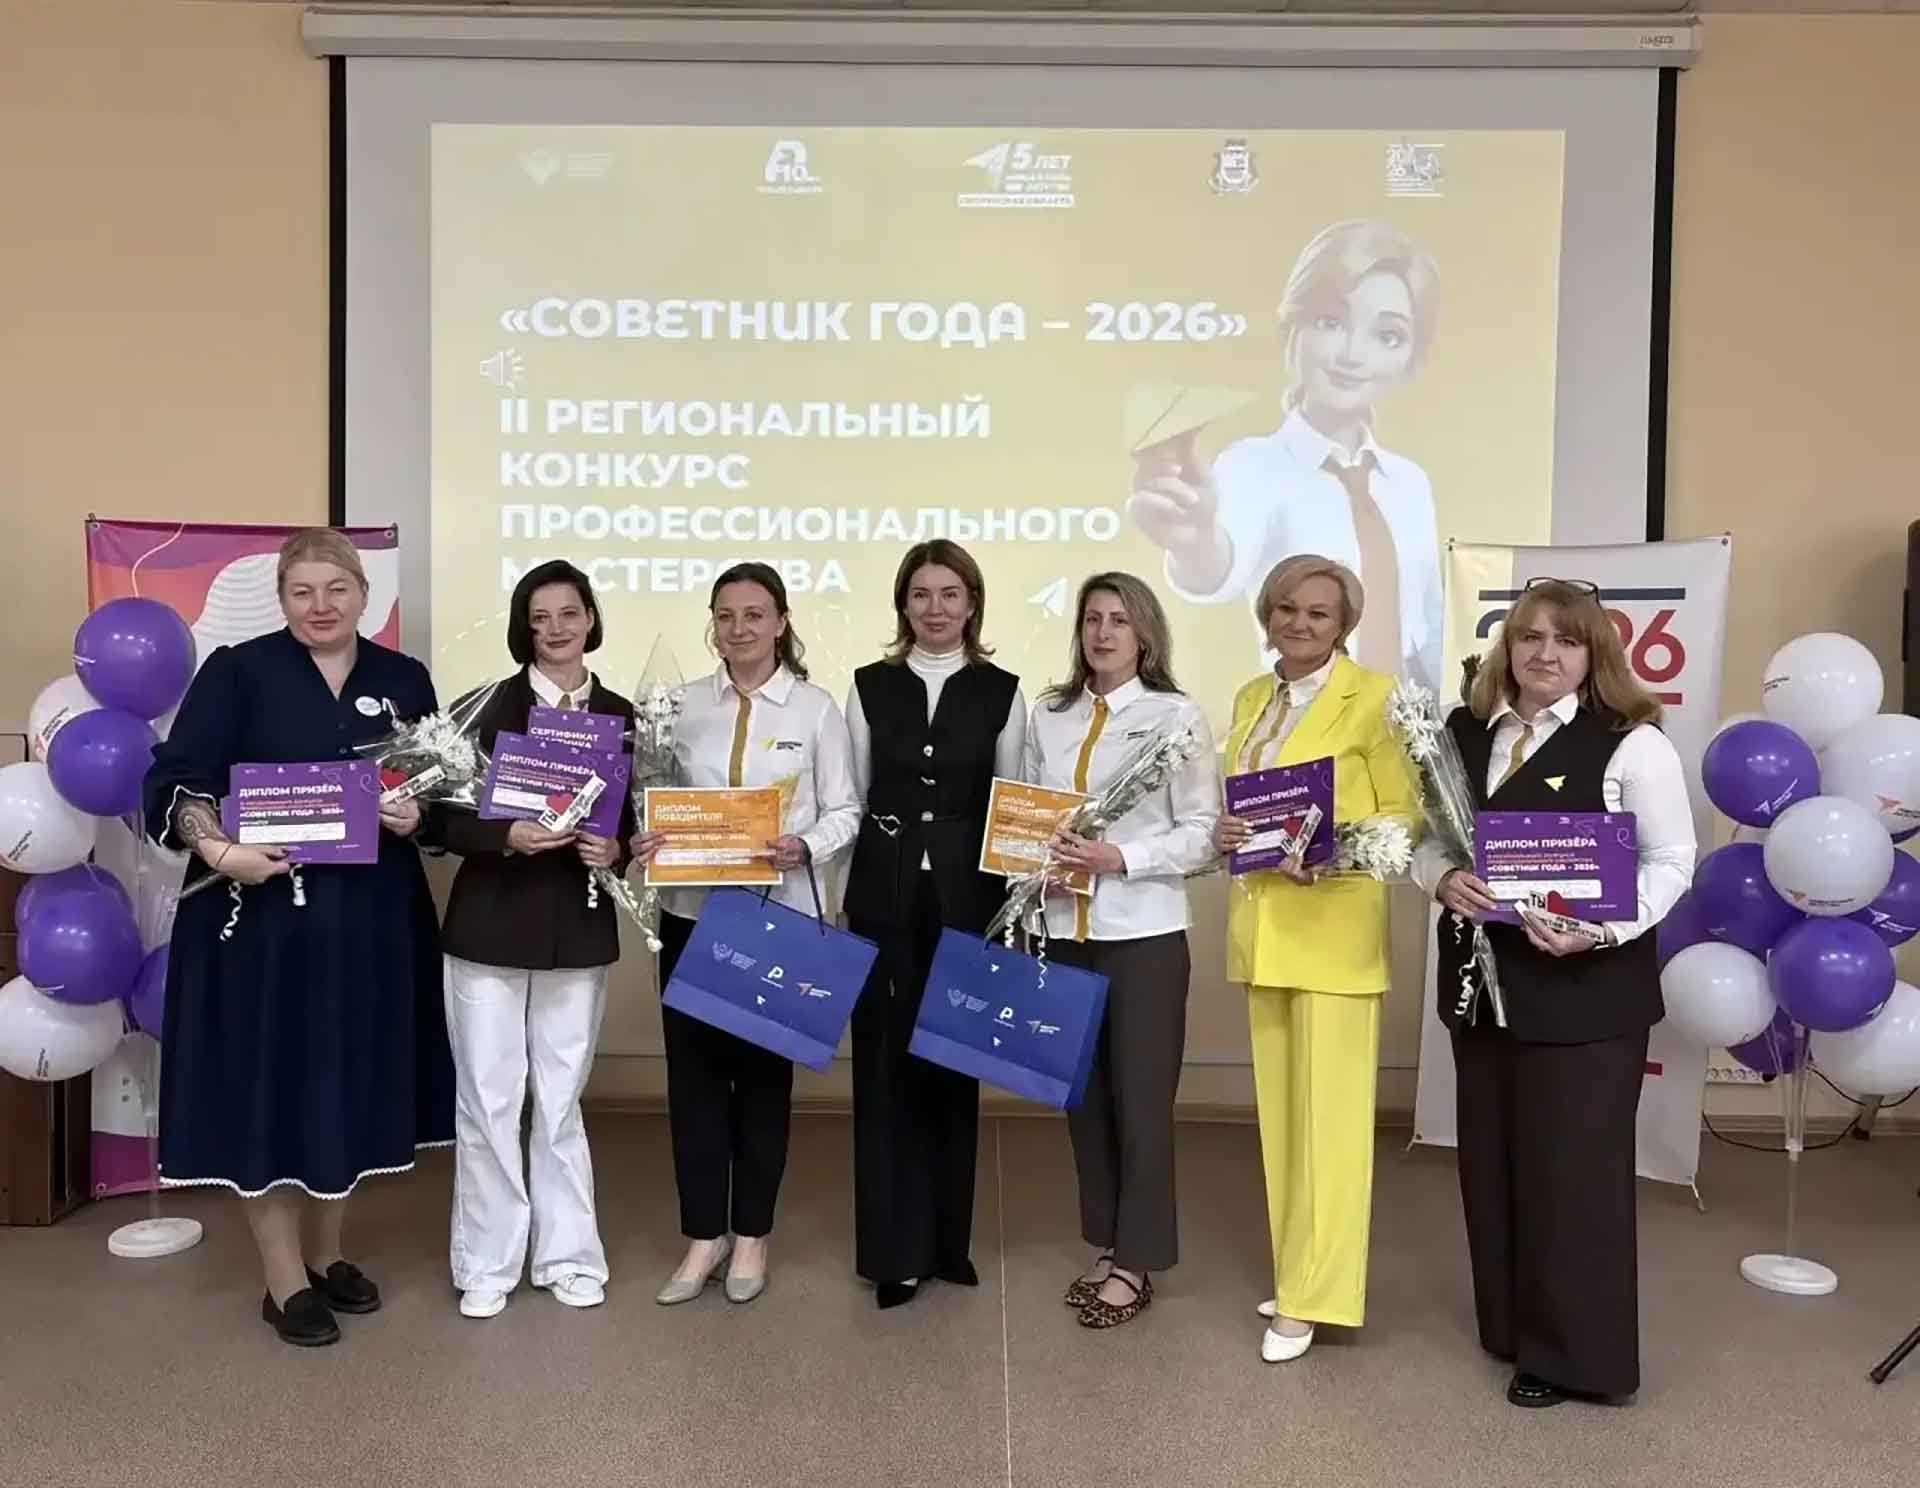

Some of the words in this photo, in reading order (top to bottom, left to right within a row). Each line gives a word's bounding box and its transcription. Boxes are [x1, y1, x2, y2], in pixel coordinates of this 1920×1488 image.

[1034, 154, 1072, 169] ЛЕТ
[500, 298, 851, 342] «СОВЕТНИК
[869, 301, 1026, 348] ГОДА
[1085, 301, 1248, 343] 2026»
[500, 398, 528, 434] II
[546, 394, 990, 438] РЕГИОНАЛЬНЫЙ
[501, 451, 751, 490] КОНКУРС
[501, 503, 1120, 542] ПРОФЕССИОНАЛЬНОГО
[531, 727, 600, 742] СЕРТИФИКАТ
[500, 752, 548, 768] ДИПЛОМ
[549, 761, 596, 776] ПРИЗЁРА
[239, 786, 290, 798] ДИПЛОМ
[292, 783, 343, 796] ПРИЗЁРА
[1233, 793, 1270, 810] ДИПЛОМ
[1485, 839, 1538, 850] ДИПЛОМ
[1541, 837, 1598, 848] ПРИЗЁРА
[1541, 863, 1566, 872] ГОДА
